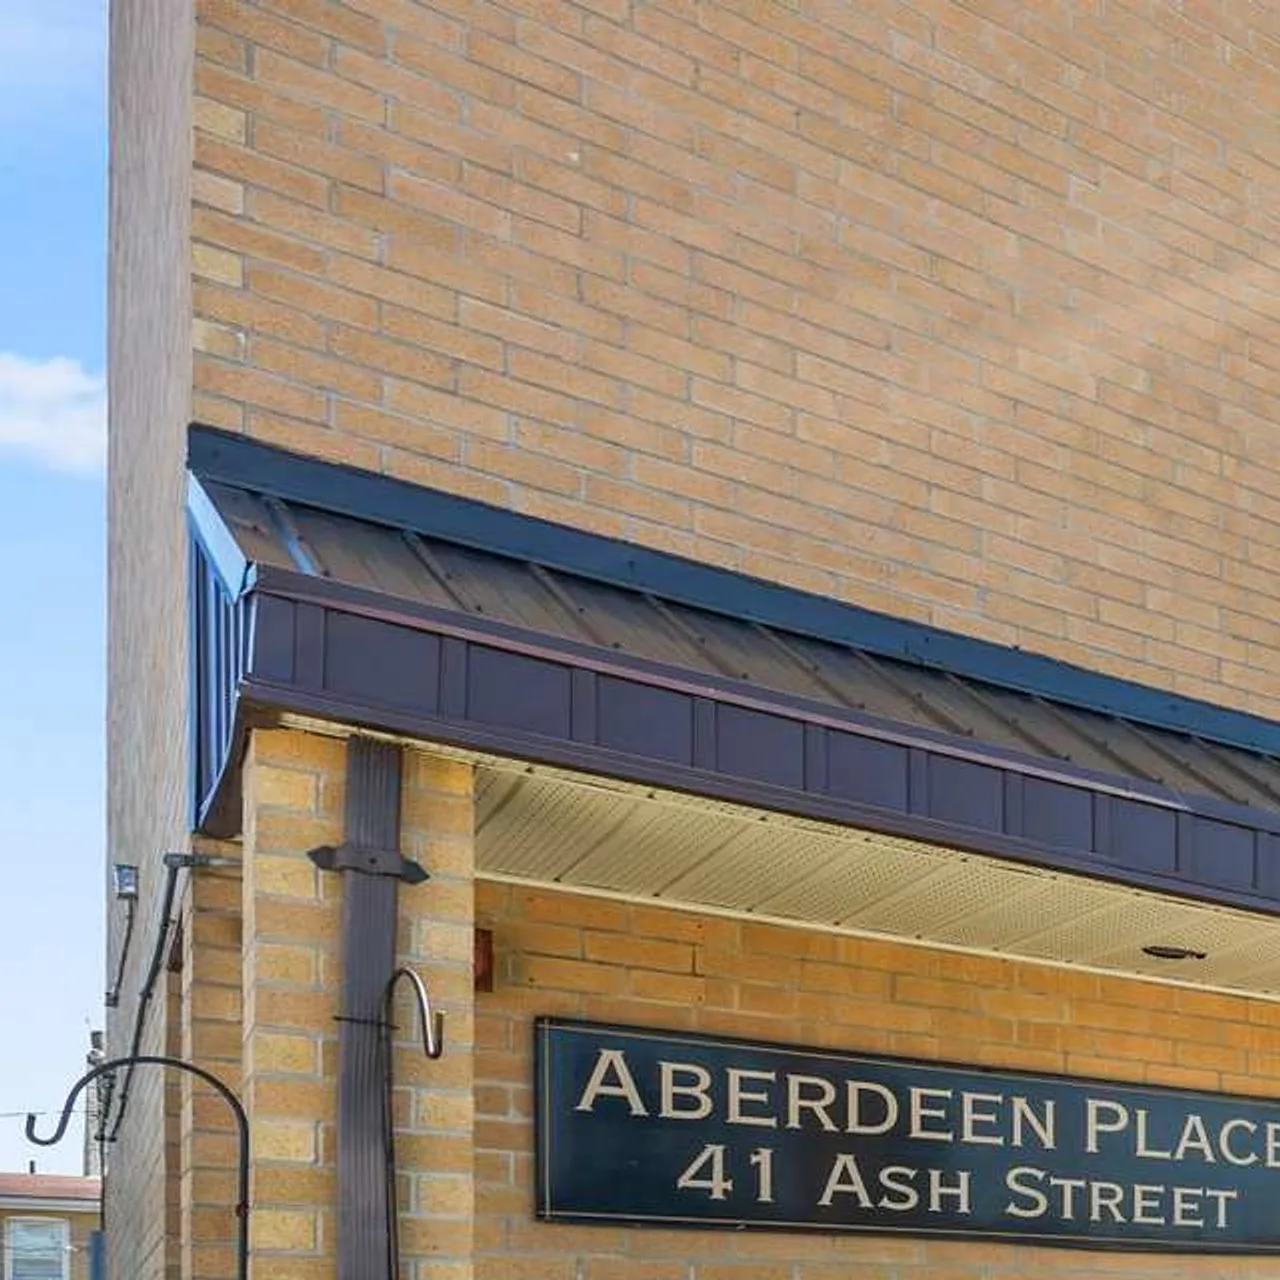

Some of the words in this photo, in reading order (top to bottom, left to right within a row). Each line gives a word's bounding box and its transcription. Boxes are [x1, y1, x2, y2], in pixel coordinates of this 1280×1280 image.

[574, 1048, 1057, 1150] ABERDEEN
[676, 1143, 775, 1203] 41
[816, 1153, 972, 1214] ASH
[1004, 1166, 1238, 1229] STREET
